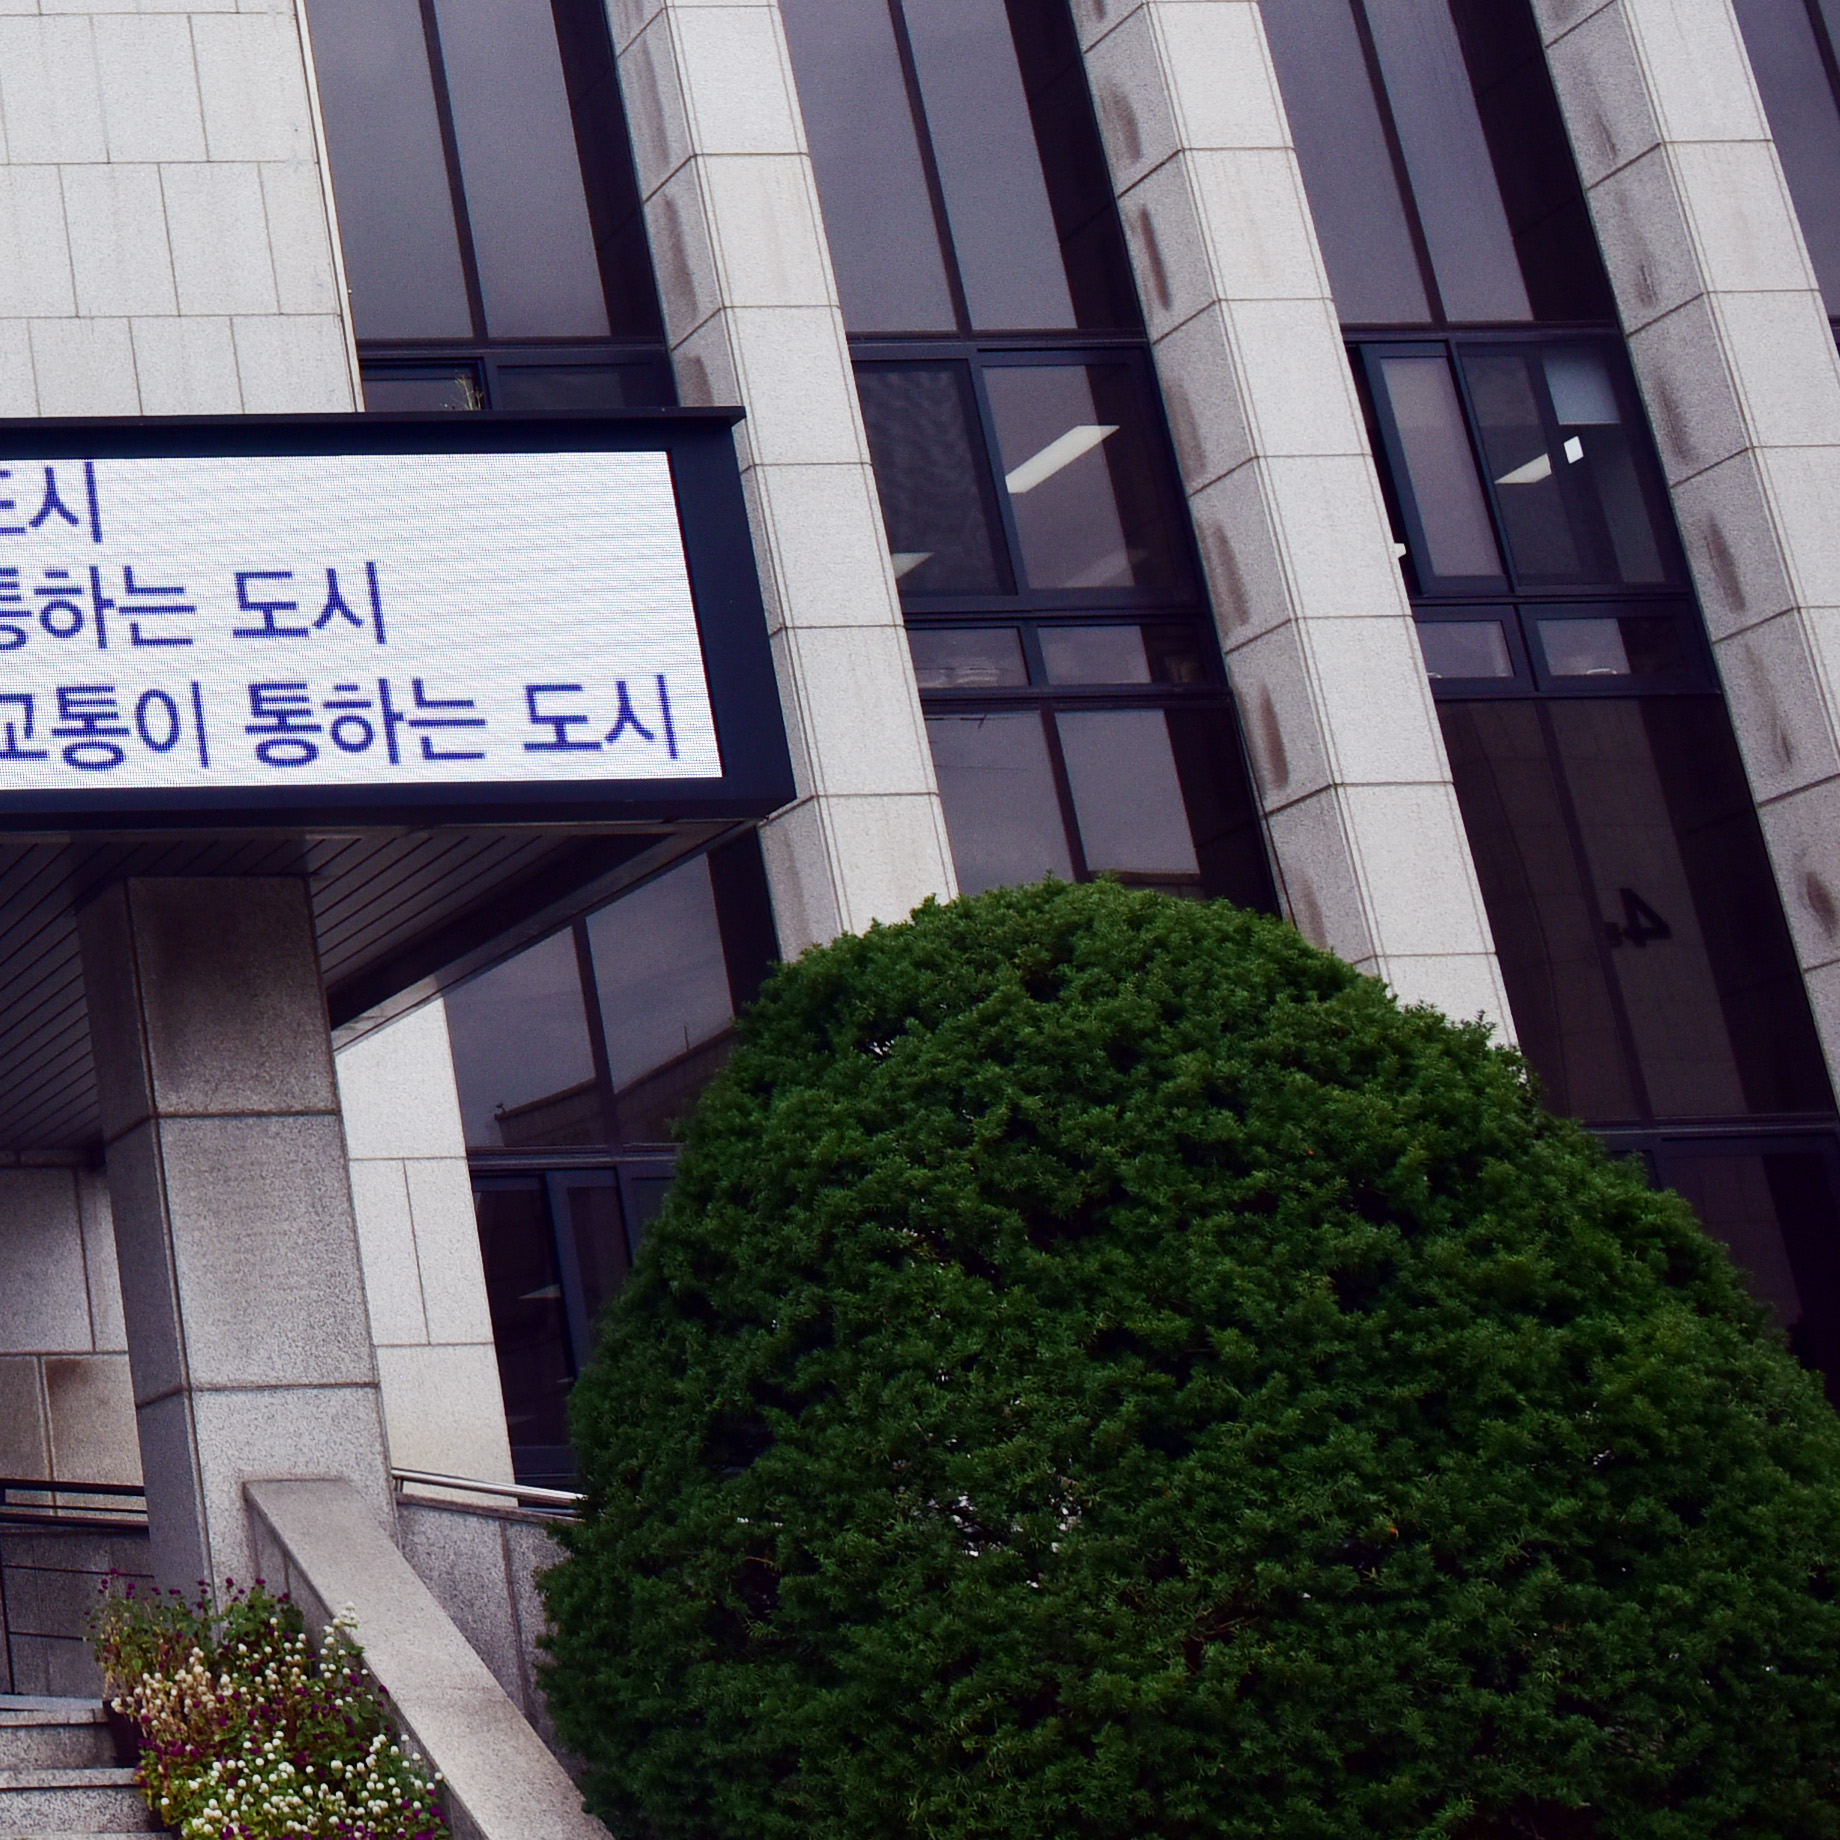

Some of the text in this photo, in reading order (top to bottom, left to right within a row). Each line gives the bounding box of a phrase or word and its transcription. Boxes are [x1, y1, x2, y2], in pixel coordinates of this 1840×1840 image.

[231, 561, 389, 645] 도시
[243, 678, 486, 766] 통하는
[522, 675, 680, 761] 도시
